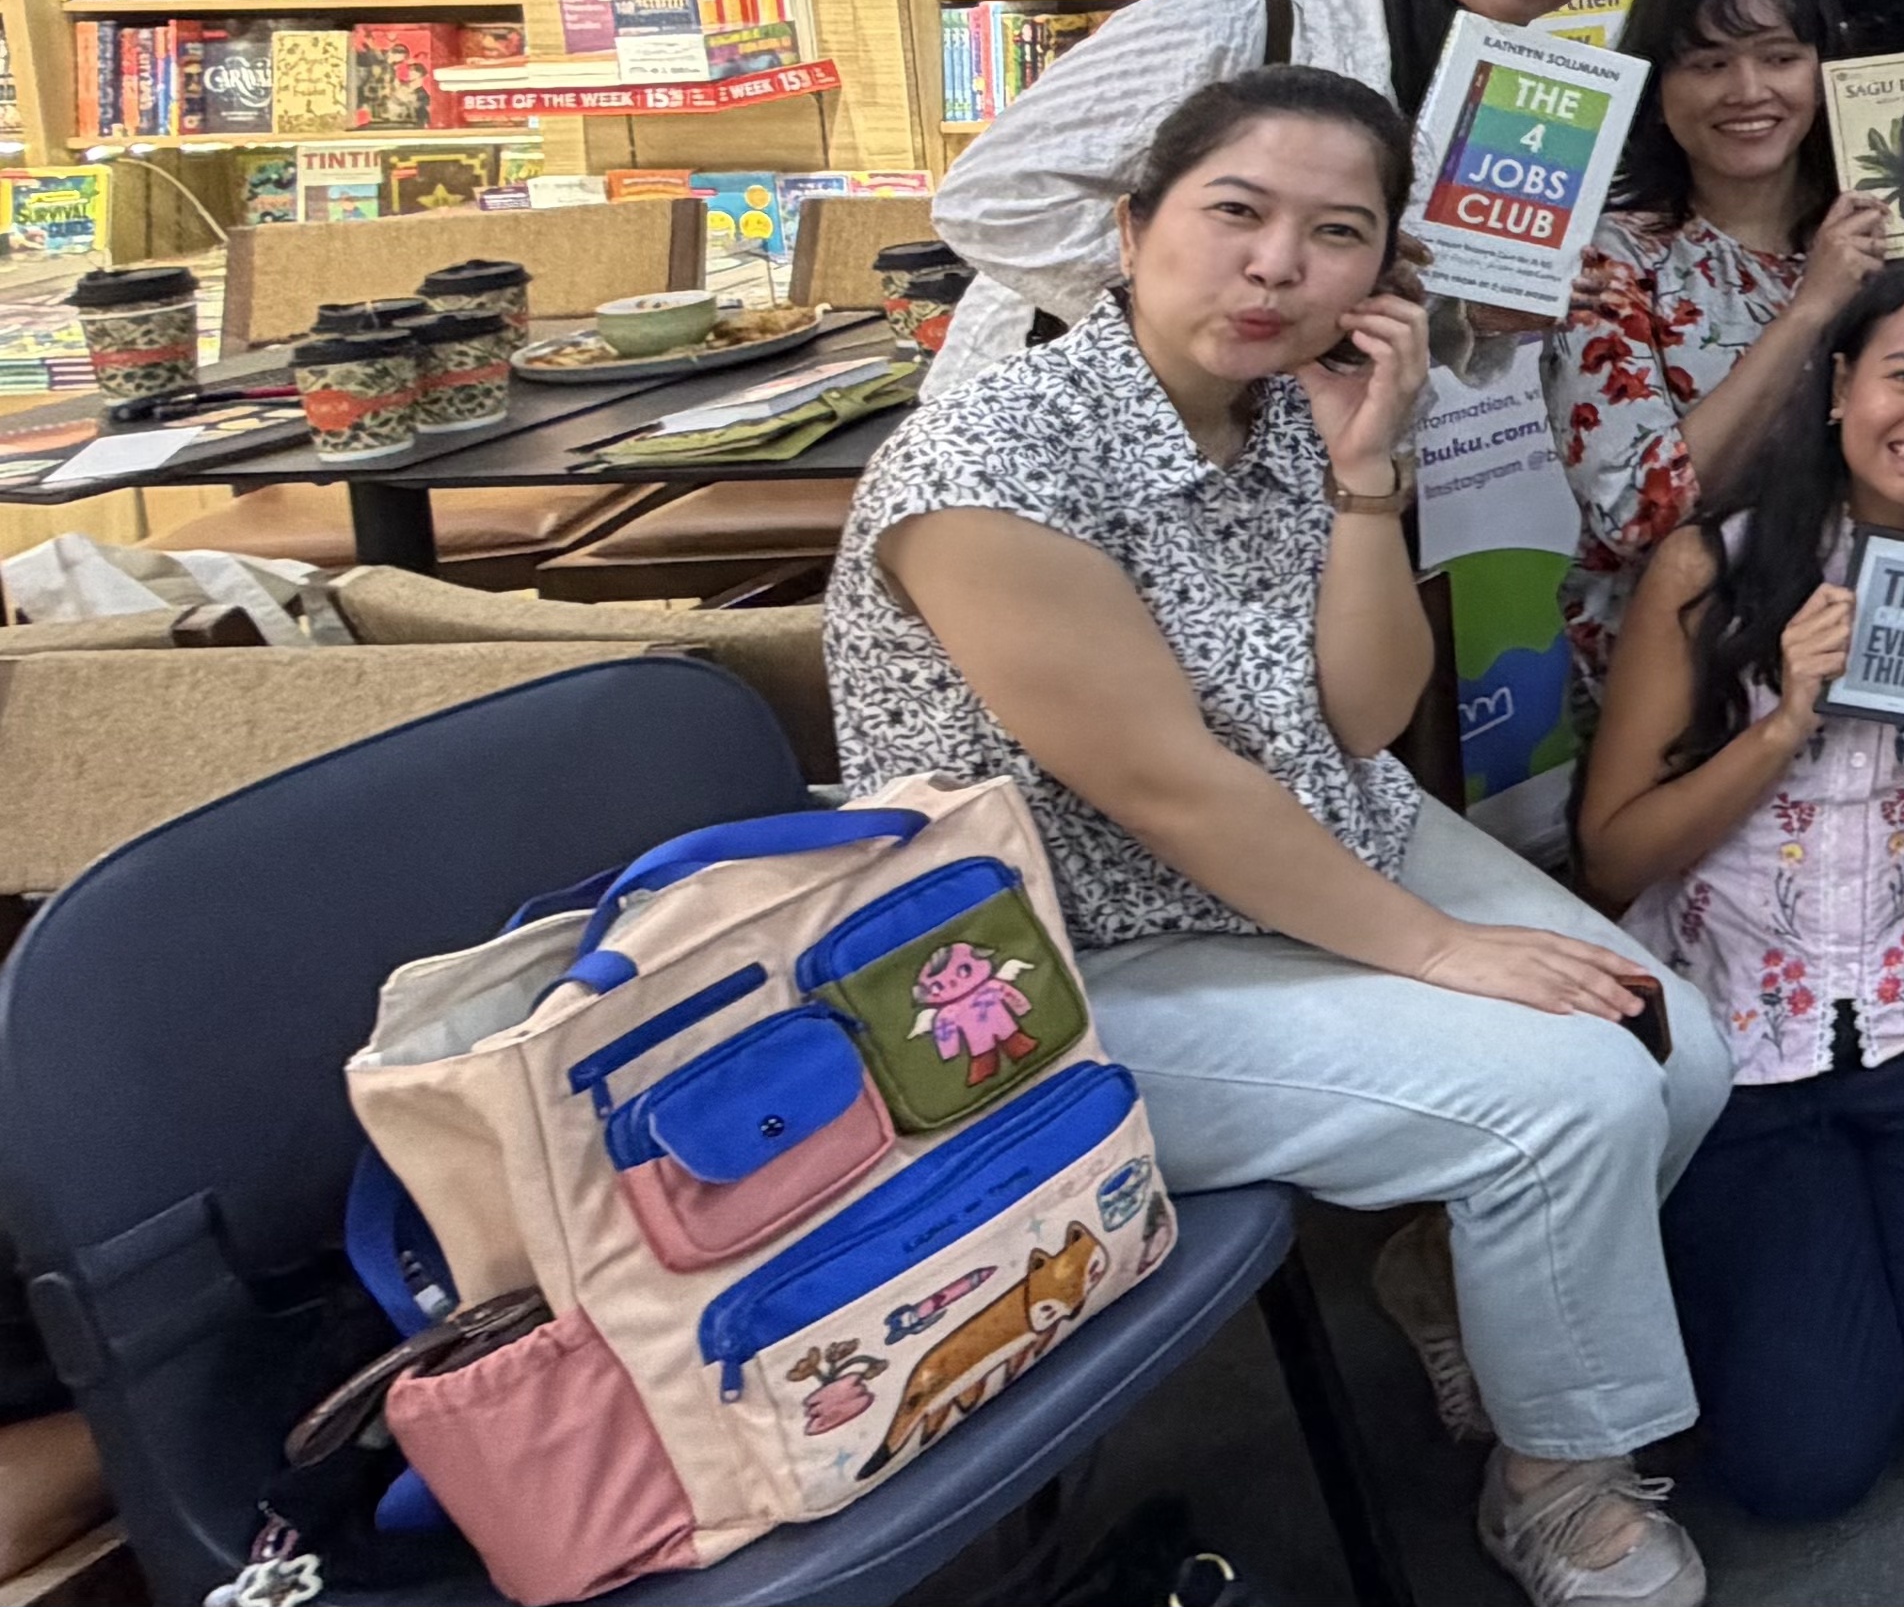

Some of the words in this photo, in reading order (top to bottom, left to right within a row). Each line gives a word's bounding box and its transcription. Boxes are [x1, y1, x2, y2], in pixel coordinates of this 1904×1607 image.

[1484, 35, 1545, 62] KATHRYN
[464, 94, 507, 112] BEST
[512, 94, 539, 110] OF
[543, 92, 575, 108] THE
[577, 90, 635, 108] WEEK
[730, 80, 774, 99] WEEK
[1515, 75, 1582, 120] THE
[1845, 80, 1895, 100] SAGU
[1520, 123, 1546, 154] 4
[1468, 154, 1570, 200] JOBS
[1456, 194, 1556, 239] CLUB
[1420, 417, 1549, 467] buku.com/
[1424, 458, 1523, 500] Instagram
